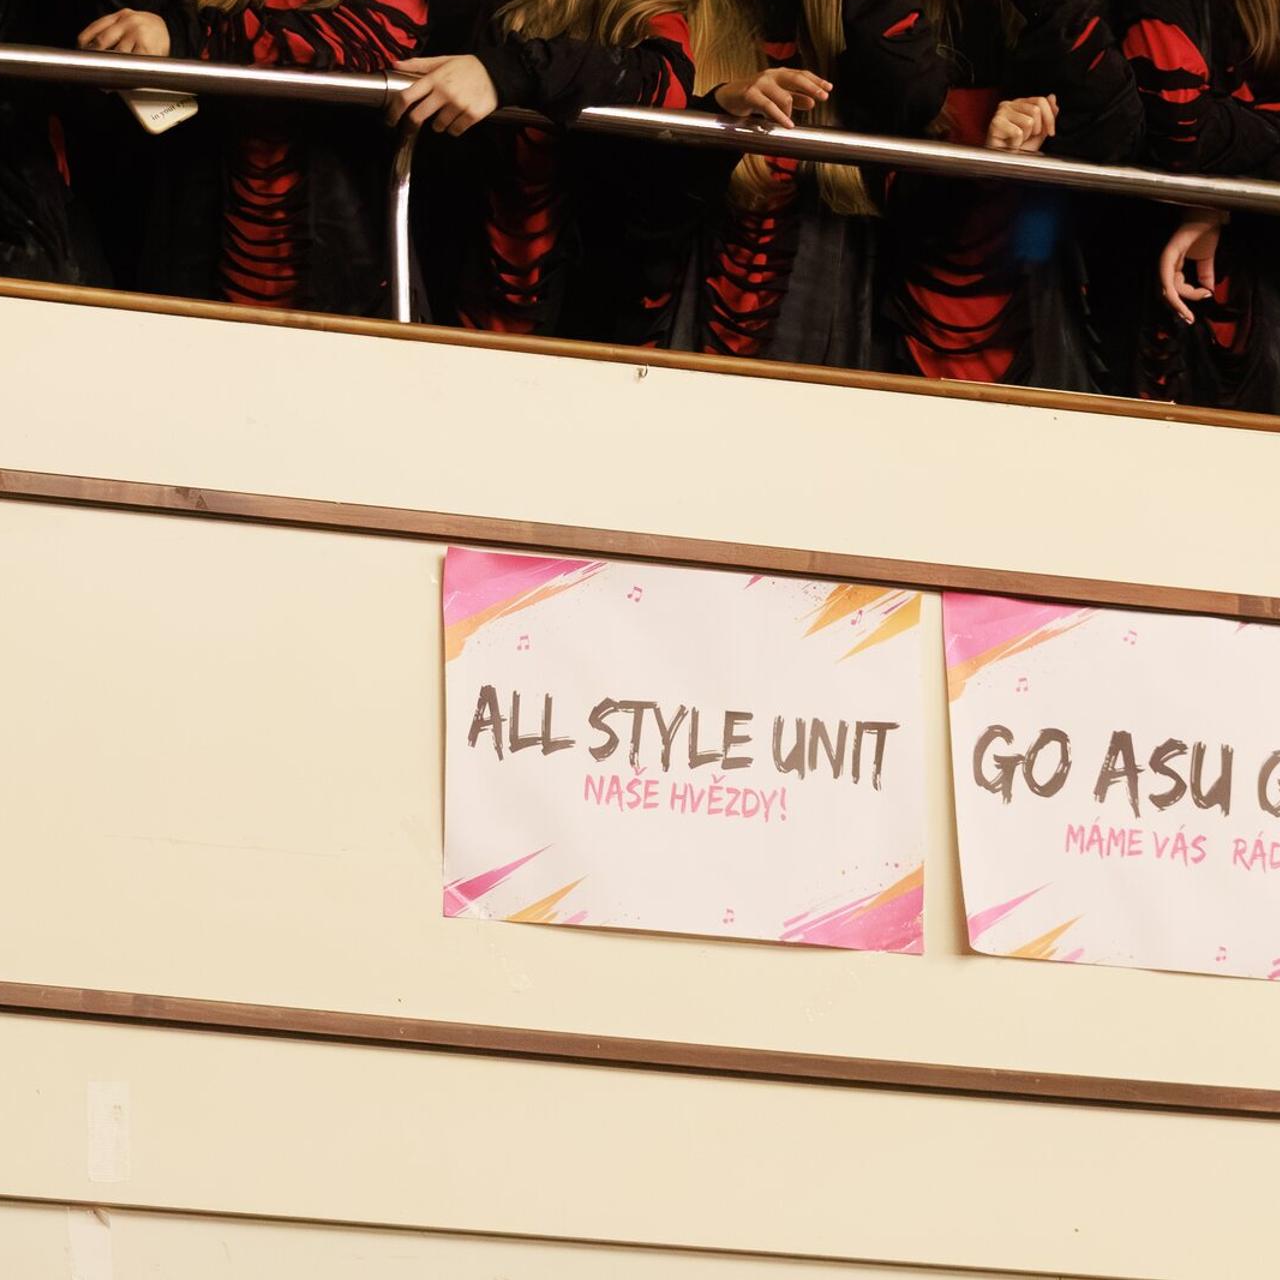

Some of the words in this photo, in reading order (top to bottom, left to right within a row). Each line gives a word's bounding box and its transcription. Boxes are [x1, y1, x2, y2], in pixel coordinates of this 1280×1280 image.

[467, 684, 576, 761] ALL
[588, 696, 754, 772] STYLE
[772, 715, 900, 792] UNIT
[972, 724, 1073, 804] GO
[1093, 730, 1234, 819] ASU
[584, 767, 660, 812] NAŠE
[670, 773, 787, 822] HVĚZDY!
[1065, 816, 1144, 859] MÁME
[1153, 823, 1208, 866] VÁS
